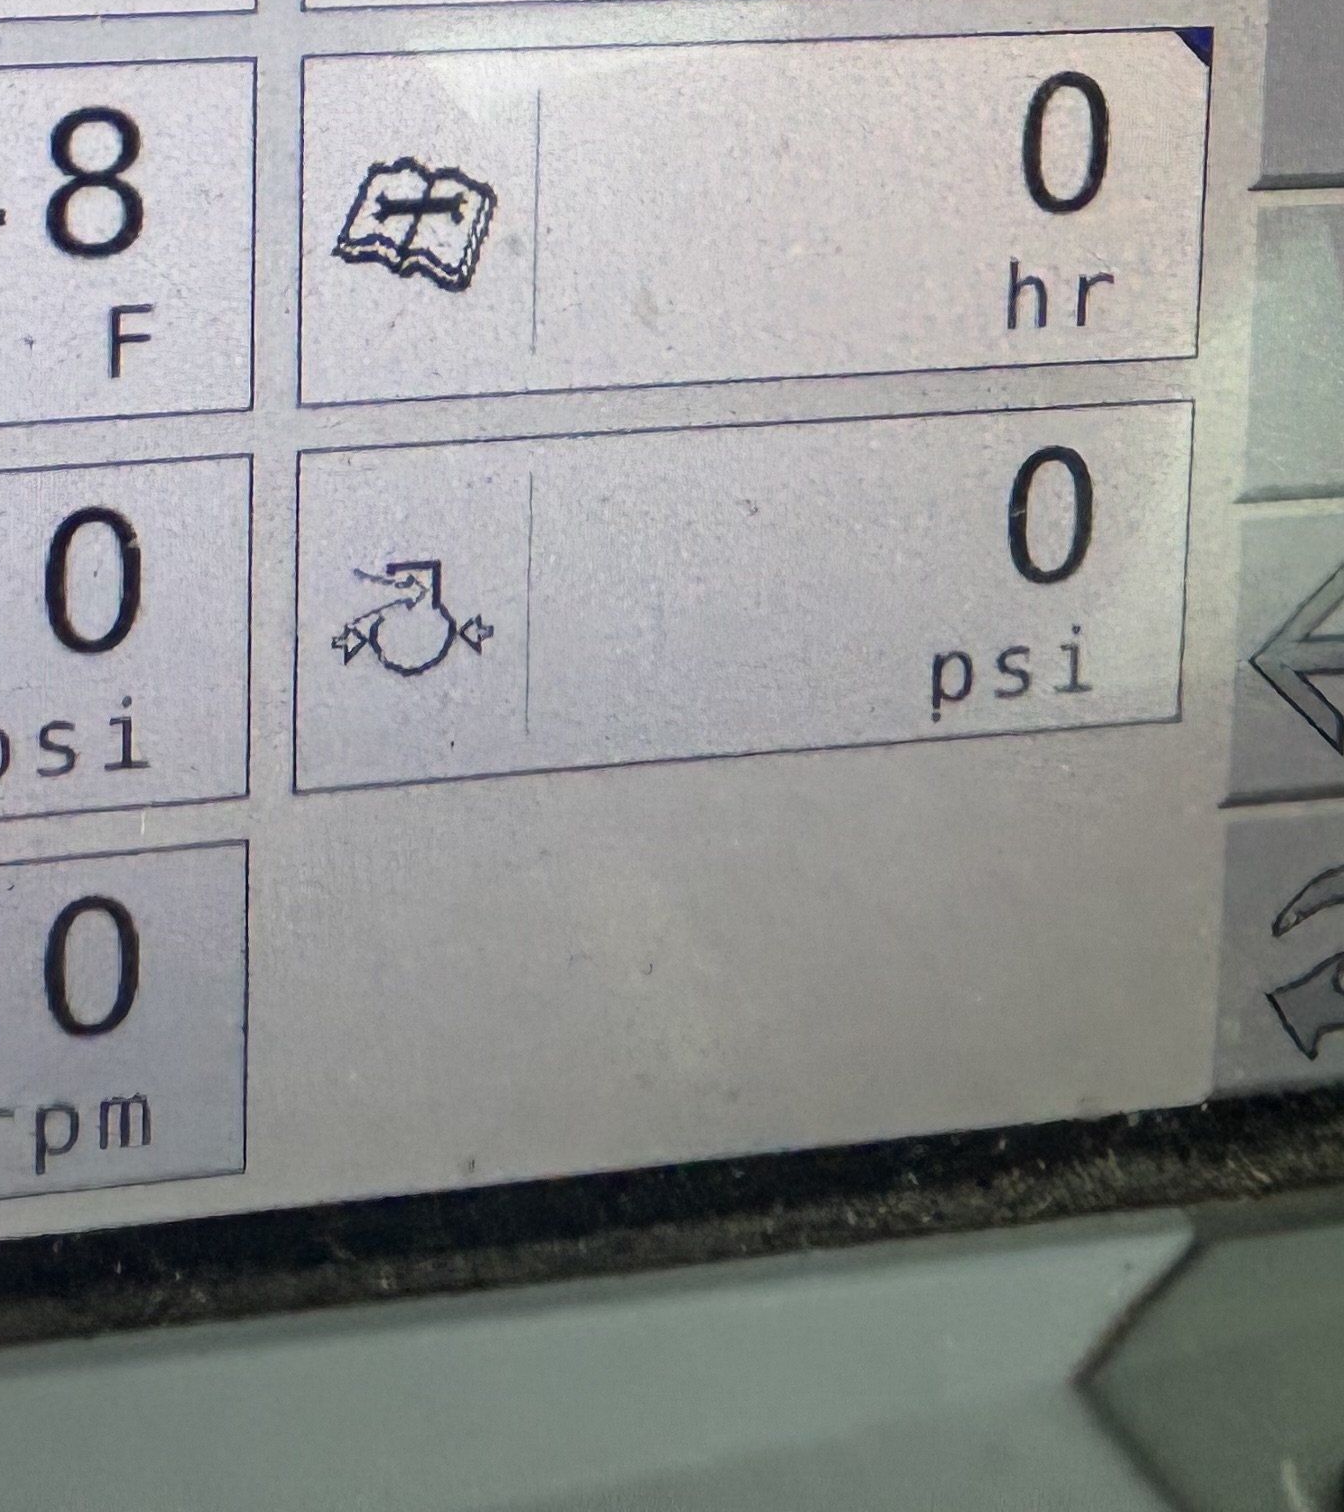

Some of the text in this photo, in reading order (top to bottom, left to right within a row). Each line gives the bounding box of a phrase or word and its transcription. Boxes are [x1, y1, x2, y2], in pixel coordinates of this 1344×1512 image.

[1022, 70, 1109, 215] 0
[109, 303, 153, 379] F
[1006, 260, 1114, 331] hr
[44, 506, 141, 655] 0
[1008, 445, 1094, 585] 0
[931, 624, 1093, 713] psi
[43, 895, 140, 1038] 0
